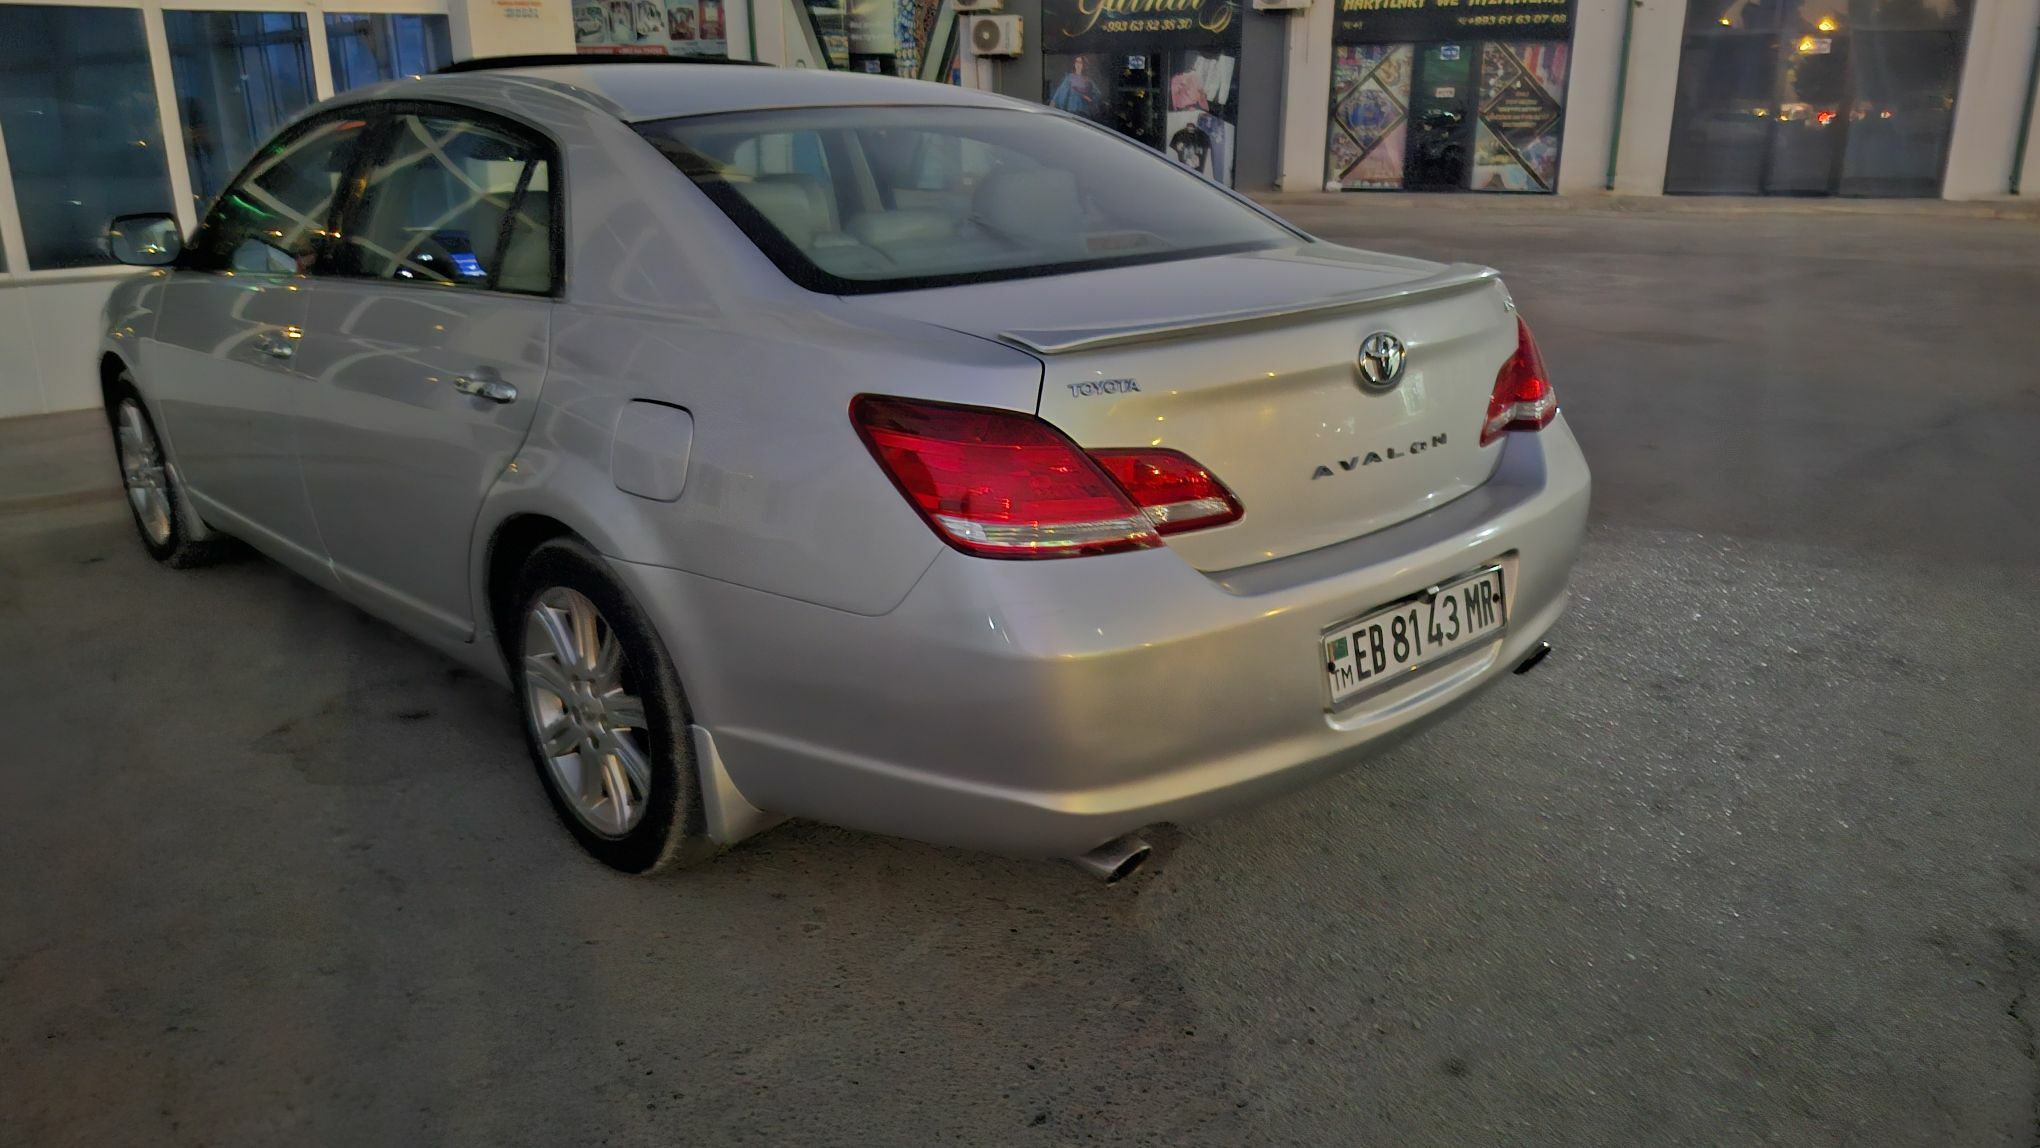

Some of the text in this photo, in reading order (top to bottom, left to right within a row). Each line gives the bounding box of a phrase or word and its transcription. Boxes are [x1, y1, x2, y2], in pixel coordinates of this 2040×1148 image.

[1066, 378, 1141, 398] TOYOTA
[1311, 432, 1447, 480] AVALON
[1352, 580, 1495, 681] EB 8143 MR
[1333, 664, 1354, 691] TM
